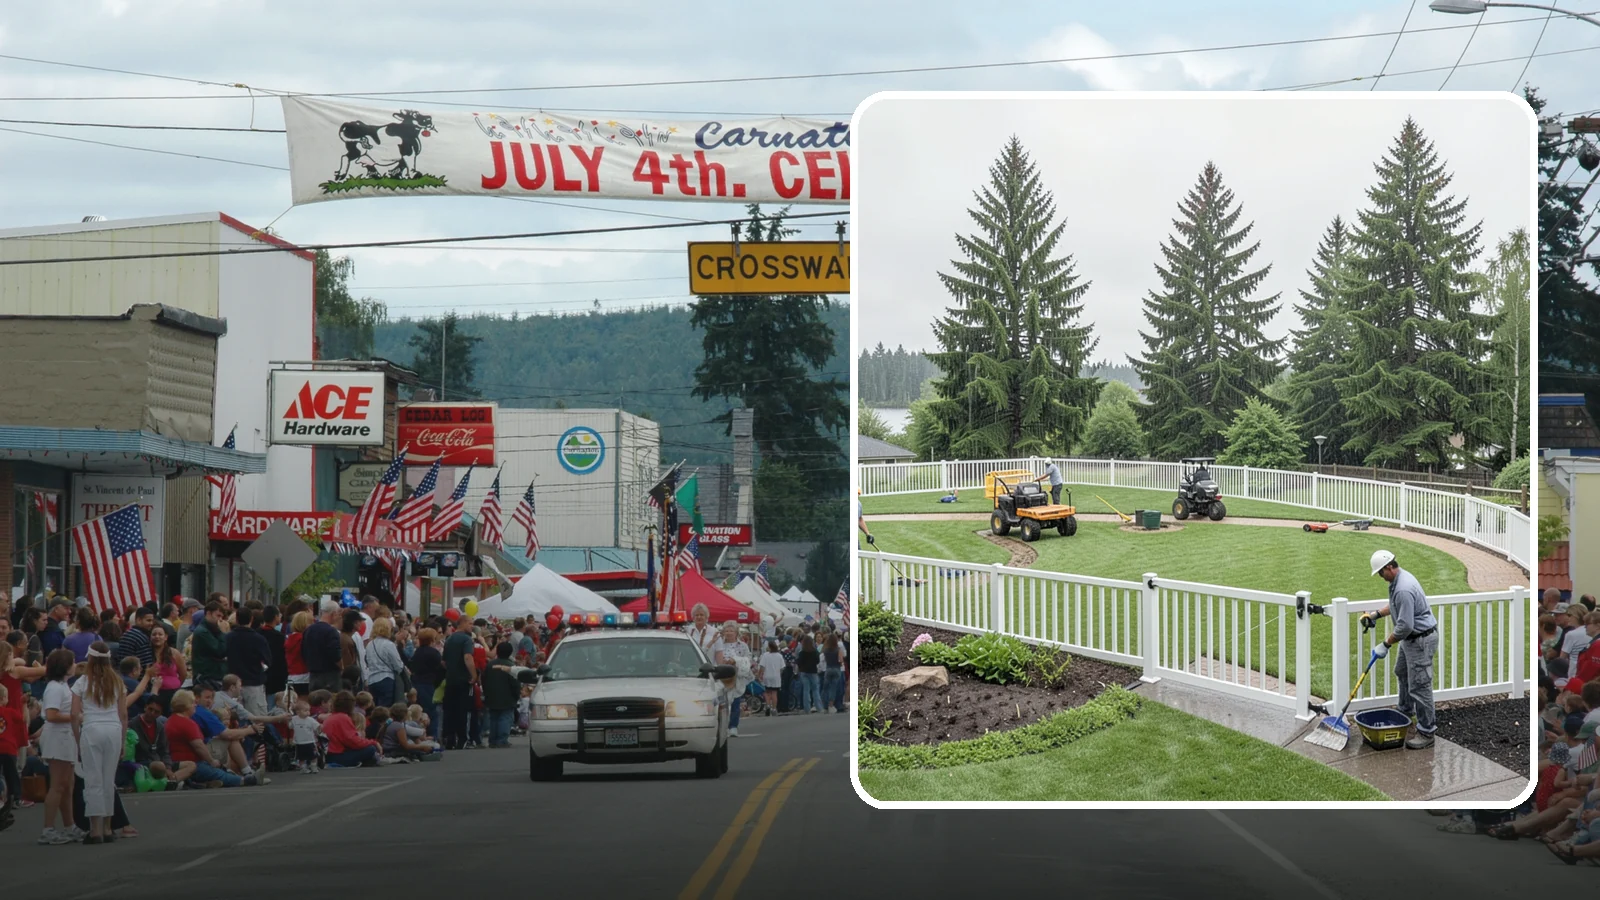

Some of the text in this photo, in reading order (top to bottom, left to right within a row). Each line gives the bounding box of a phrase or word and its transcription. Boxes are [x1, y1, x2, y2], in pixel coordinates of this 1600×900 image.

[695, 121, 850, 149] Carnat
[481, 141, 604, 192] JULY
[632, 150, 747, 197] 4th.
[697, 254, 850, 280] CROSSWA
[282, 380, 373, 420] ACE
[406, 409, 453, 422] CEDAR
[283, 421, 371, 436] Hardware
[416, 428, 477, 447] Coca-Cola
[353, 467, 385, 480] Simpl
[83, 485, 155, 495] St. Vincent de Paul
[80, 503, 154, 523] THRT
[688, 526, 741, 535] CRNATION
[699, 535, 730, 543] GLASS
